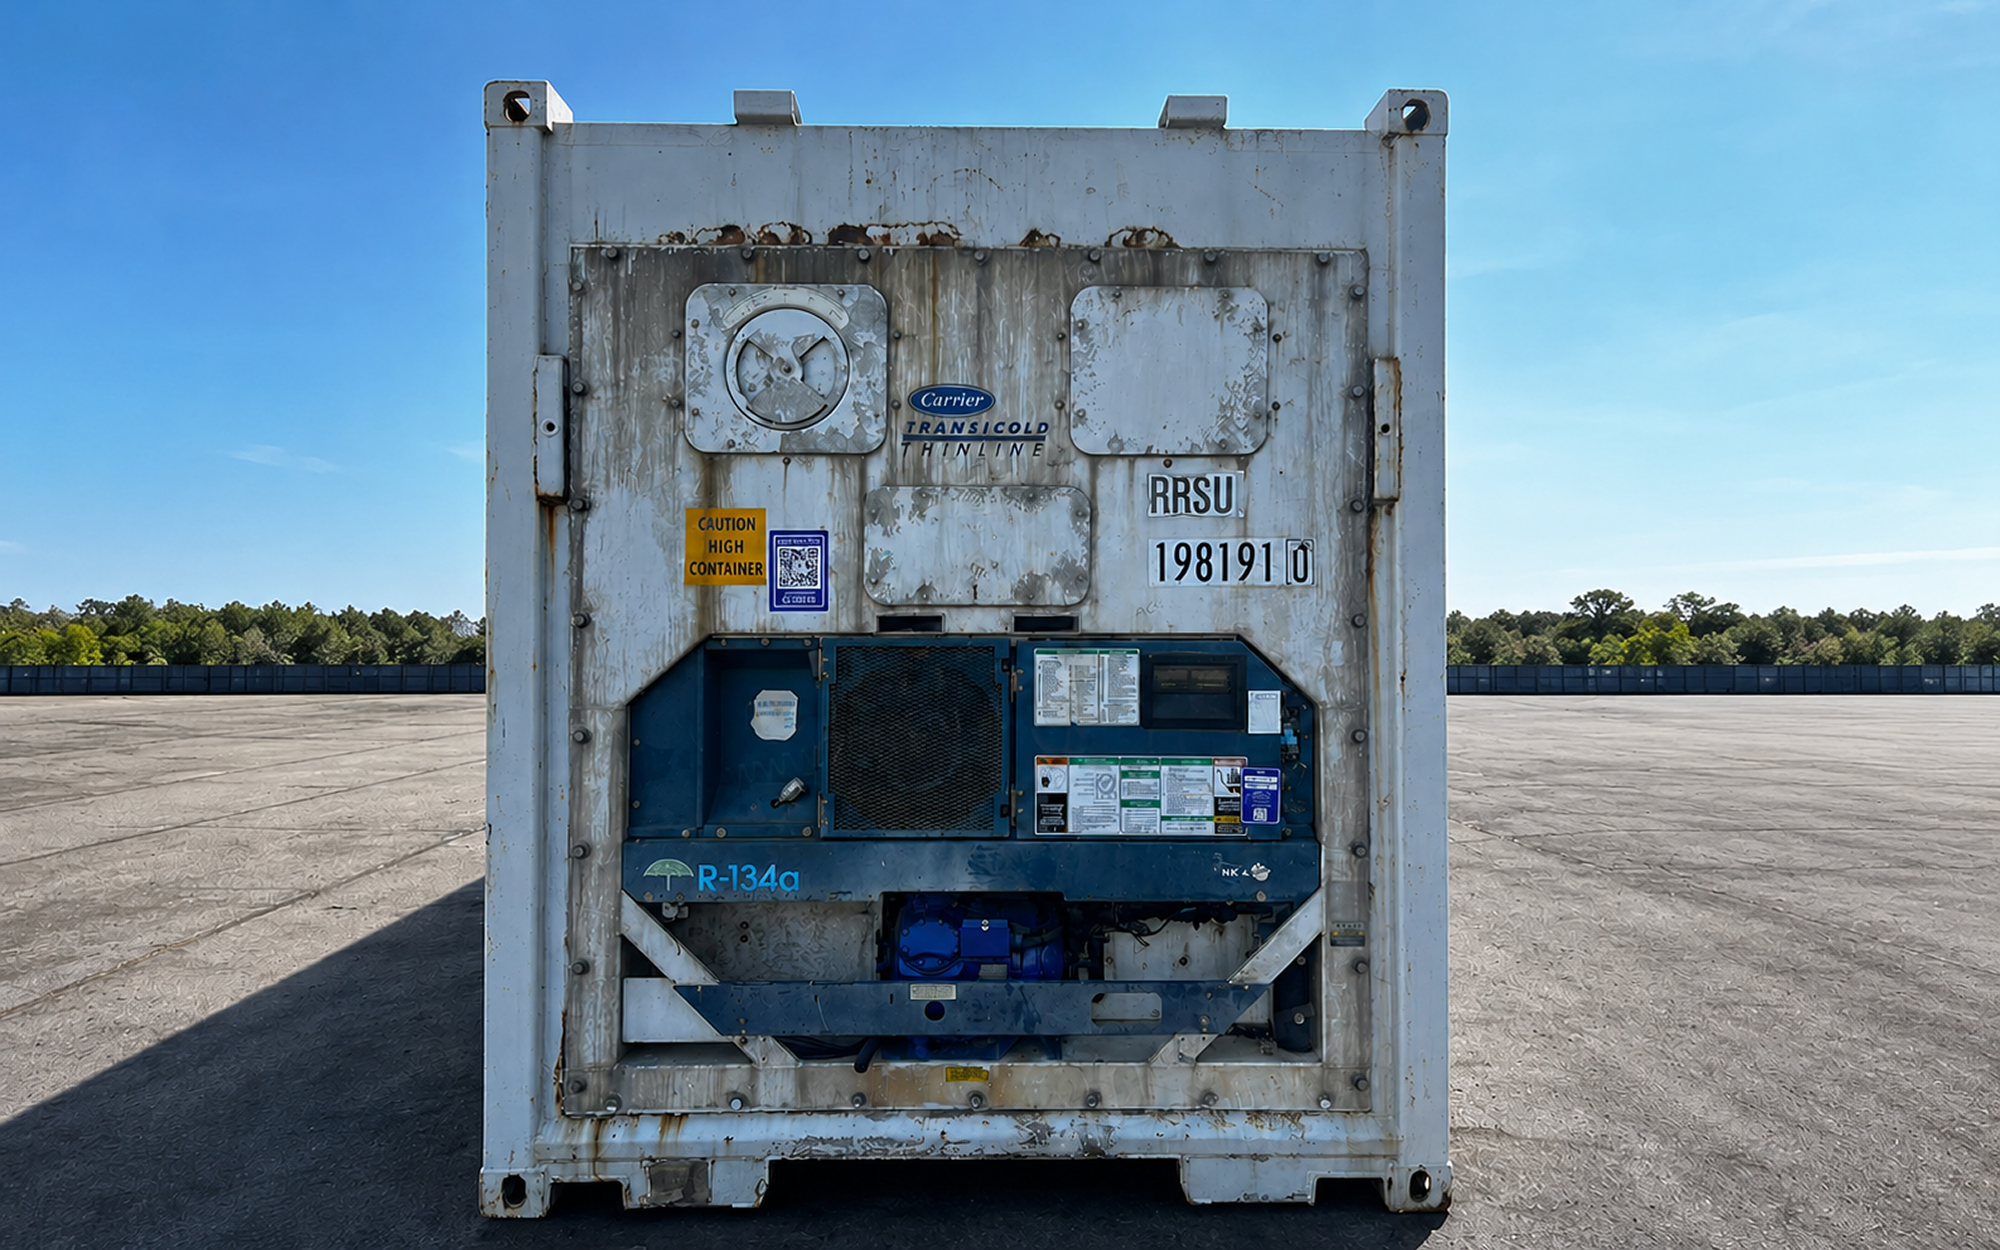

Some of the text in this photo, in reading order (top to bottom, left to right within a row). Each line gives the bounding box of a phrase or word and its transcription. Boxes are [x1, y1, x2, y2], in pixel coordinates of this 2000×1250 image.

[920, 392, 985, 408] Carrier
[906, 421, 1049, 434] TRANSICOLD
[901, 442, 1044, 457] THINLINE
[1150, 475, 1233, 514] RRSU
[698, 517, 756, 531] CAUTION
[708, 539, 744, 554] HIGH
[689, 561, 763, 576] CONTAINER
[1155, 542, 1271, 583] 198191
[698, 864, 799, 892] R-134a
